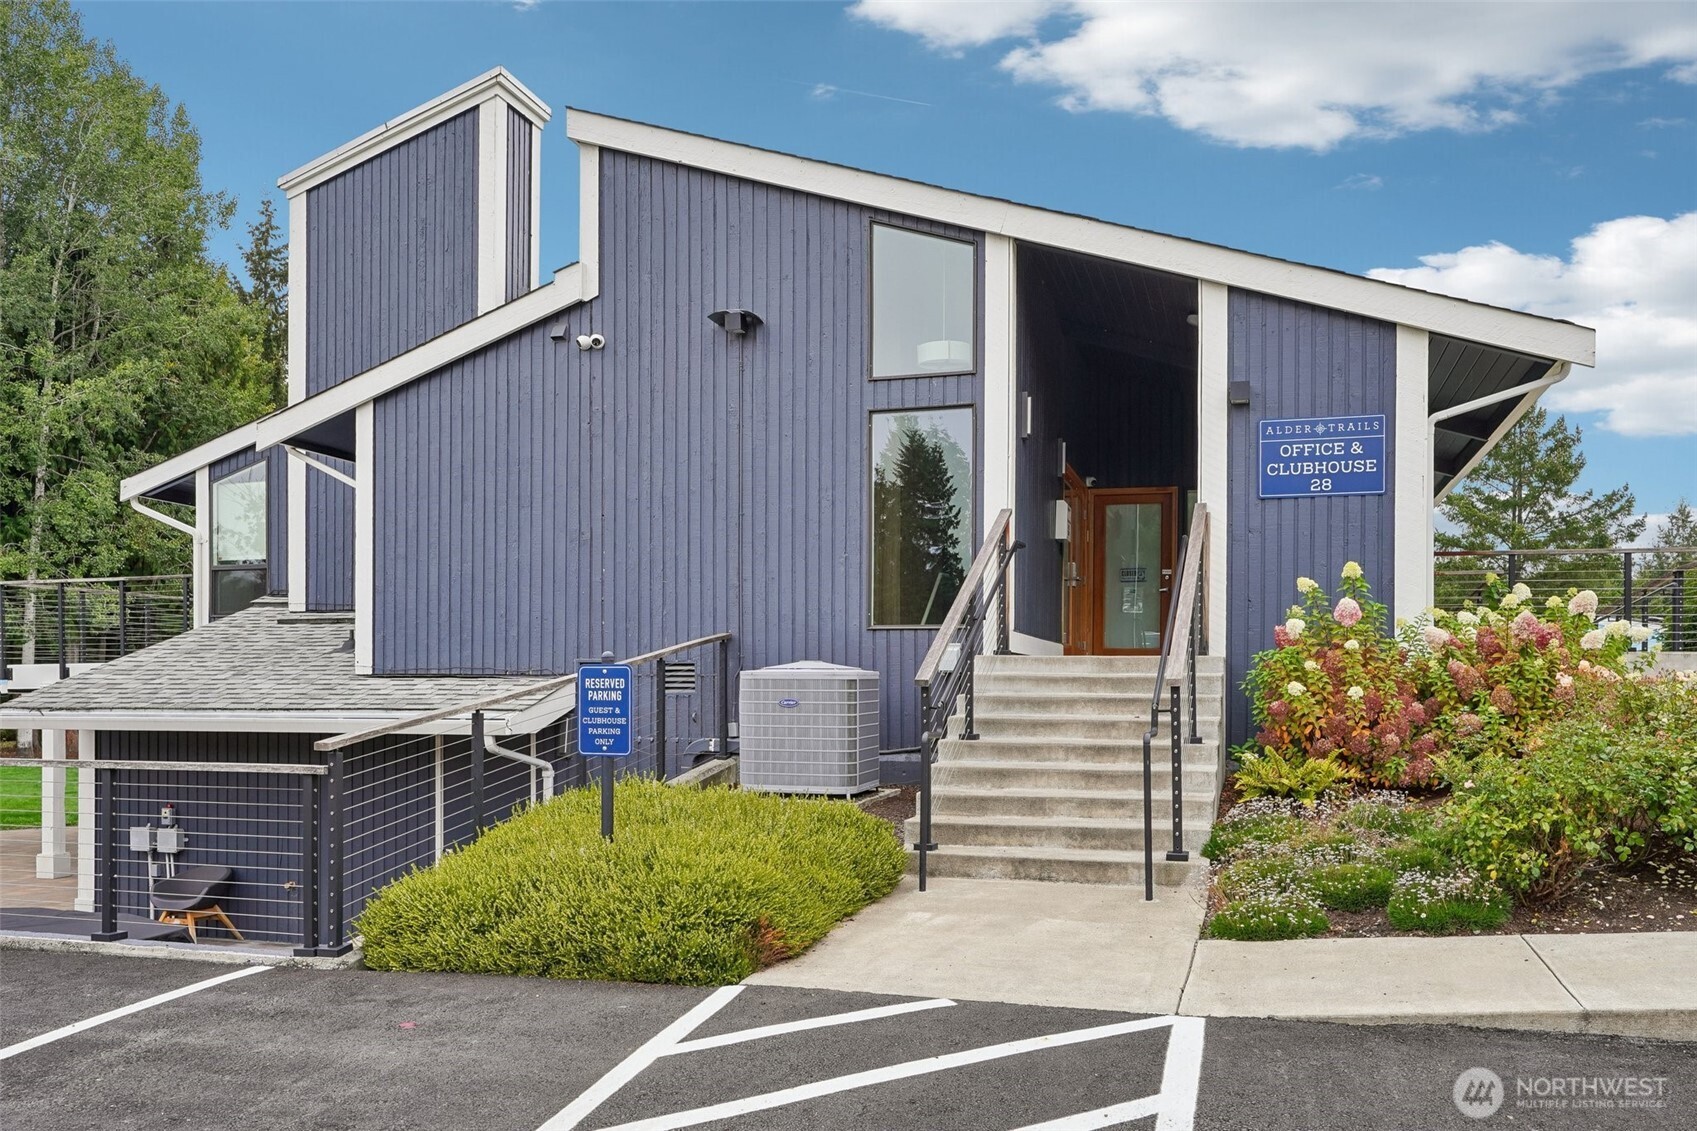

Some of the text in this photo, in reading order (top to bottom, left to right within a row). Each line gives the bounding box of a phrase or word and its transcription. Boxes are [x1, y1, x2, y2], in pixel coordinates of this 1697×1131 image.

[1266, 421, 1380, 435] ALDER TRAILS
[1280, 441, 1364, 457] OFFICE &
[1266, 459, 1377, 476] CLUBHOUSE
[1310, 478, 1332, 491] 28
[585, 678, 625, 689] RESERVED
[588, 690, 622, 701] PARKING
[588, 706, 620, 714] GUEST &
[582, 717, 627, 725] CLUBHOUSE
[588, 727, 621, 735] PARKING
